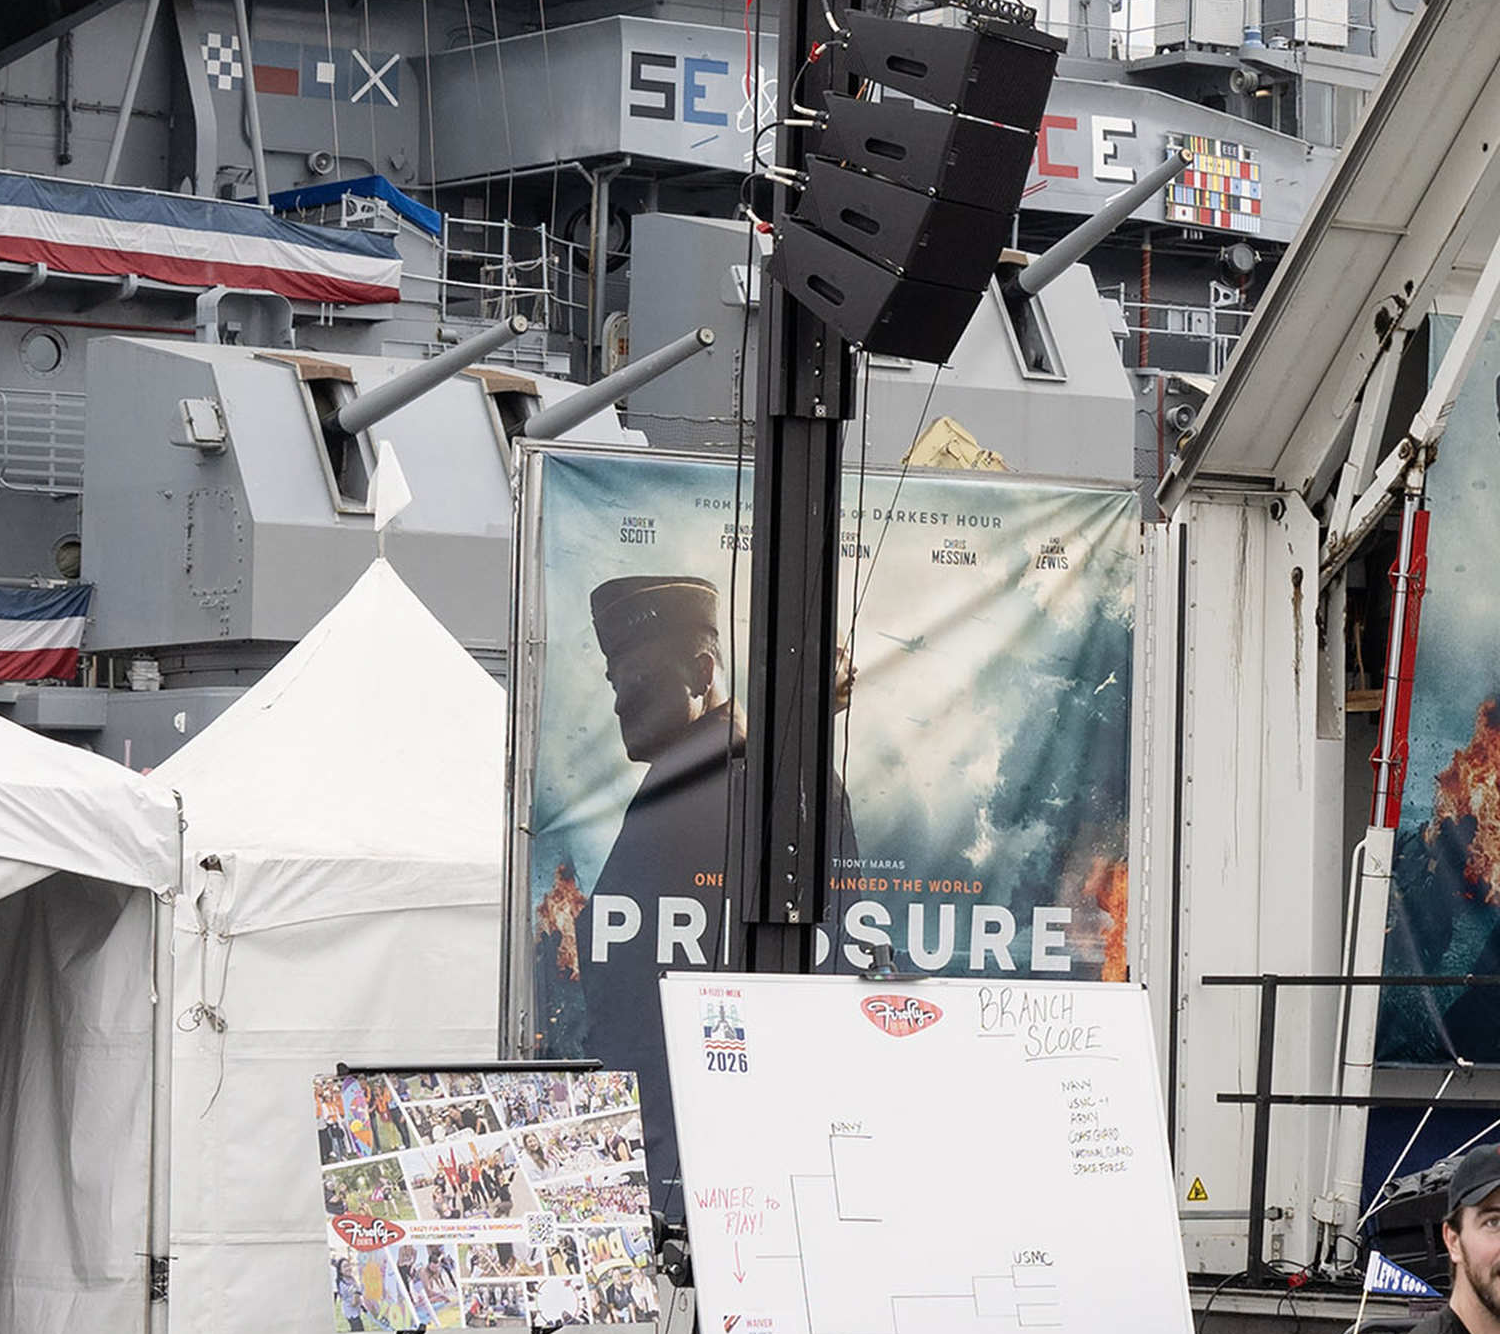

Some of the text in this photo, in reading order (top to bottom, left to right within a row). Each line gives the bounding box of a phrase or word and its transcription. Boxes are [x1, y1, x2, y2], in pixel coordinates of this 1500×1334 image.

[622, 516, 655, 528] ANDREW
[695, 499, 731, 510] FROM
[873, 508, 949, 525] DARKEST
[956, 514, 1002, 529] HOUR
[620, 528, 656, 545] SCOTT
[932, 549, 977, 566] MESSINA
[1036, 556, 1069, 569] LEWIS
[892, 879, 923, 892] THE
[928, 880, 983, 894] WORLD
[867, 998, 935, 1030] Firefly
[978, 986, 1075, 1033] BRANCH
[1024, 1025, 1102, 1057] SCORE
[706, 1051, 748, 1073] 2026
[830, 1121, 864, 1135] NAVY
[338, 1219, 398, 1244] Firefly
[1012, 1249, 1053, 1268] USMC
[1373, 1260, 1400, 1291] LET'S
